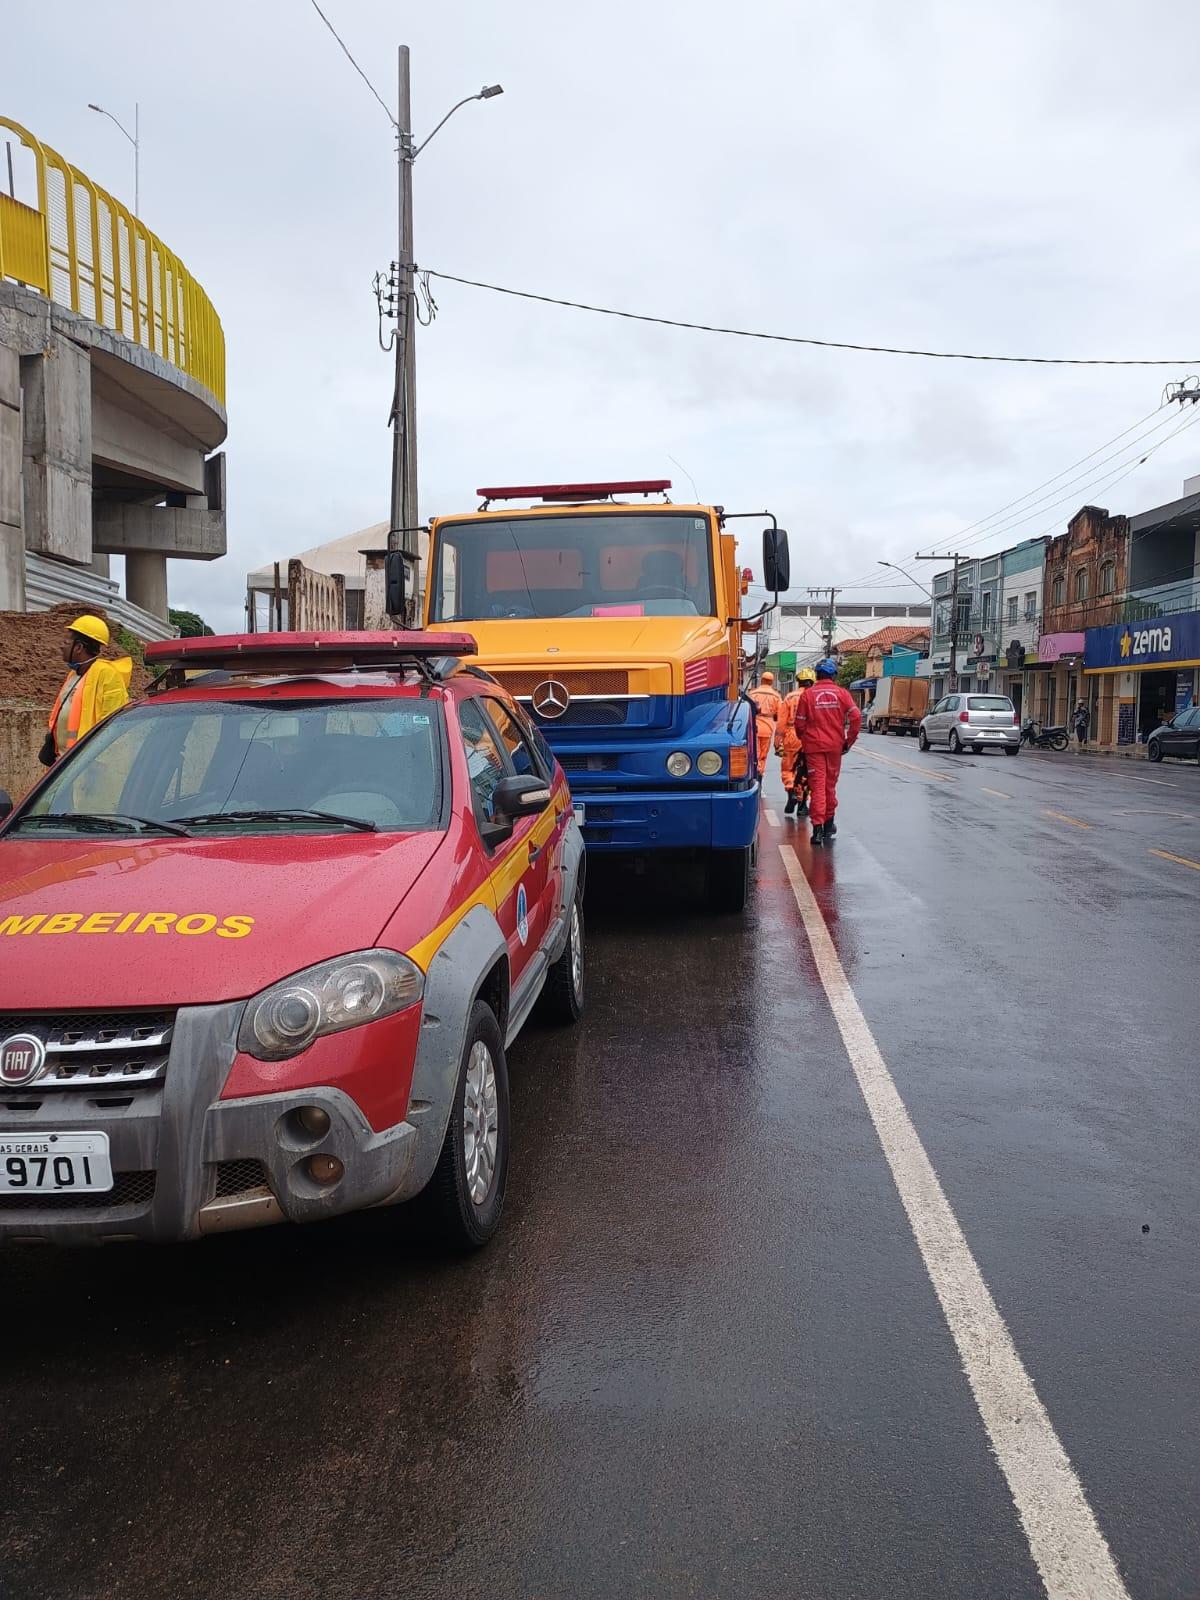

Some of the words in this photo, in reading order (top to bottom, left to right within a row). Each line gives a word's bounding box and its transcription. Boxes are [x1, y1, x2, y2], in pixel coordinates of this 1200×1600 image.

[1133, 627, 1171, 655] zema
[5, 1051, 31, 1070] FIAT
[15, 1144, 49, 1153] GERAIS
